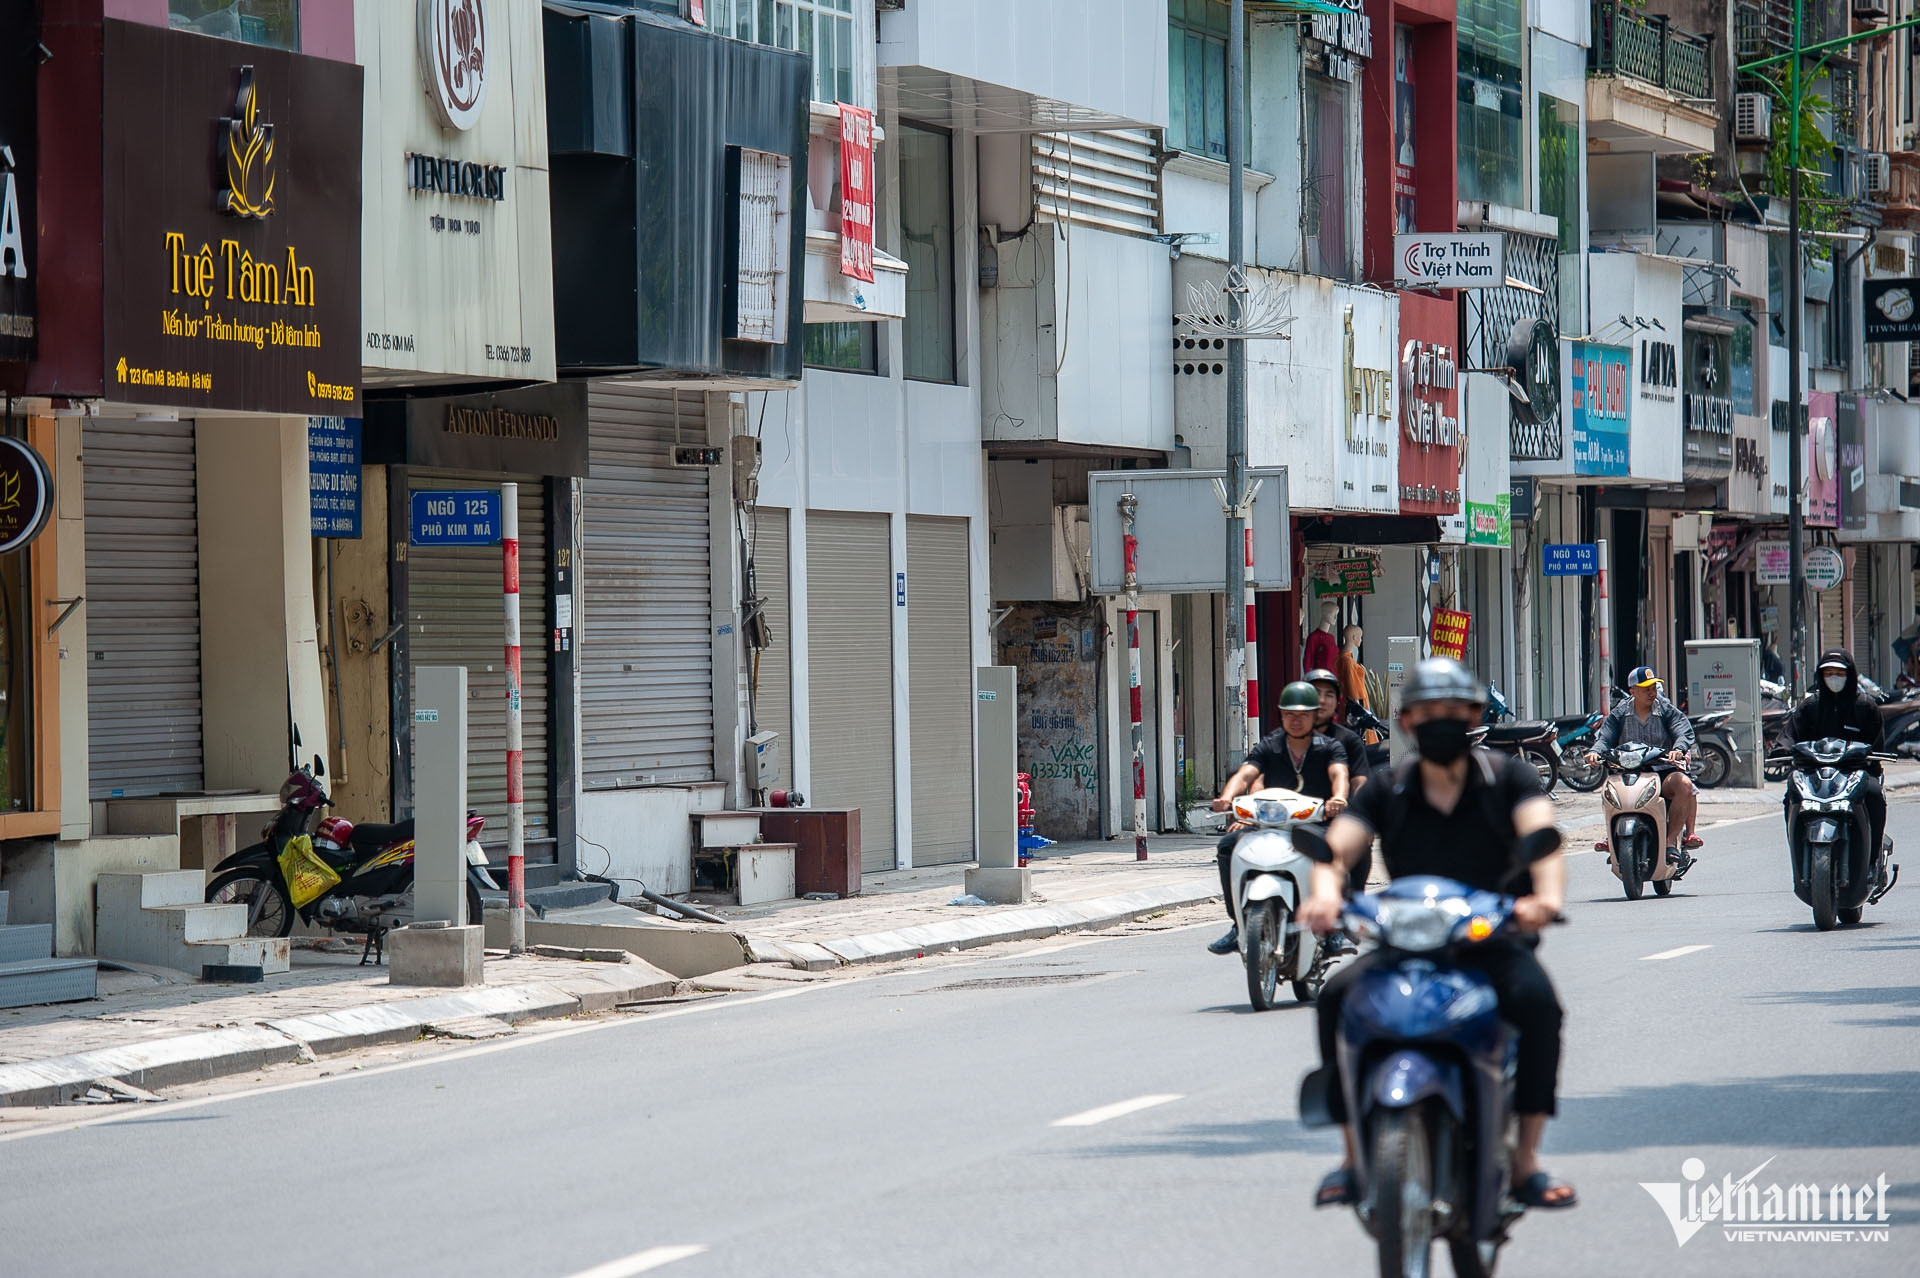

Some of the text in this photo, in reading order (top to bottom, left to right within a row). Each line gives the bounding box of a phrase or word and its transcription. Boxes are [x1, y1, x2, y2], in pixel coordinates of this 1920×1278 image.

[850, 154, 863, 191] NHÀ
[1422, 241, 1490, 260] Trợ Thính
[165, 231, 315, 310] Tuệ Tâm An
[1422, 261, 1493, 279] Việt Nam
[162, 309, 183, 336] Nến
[184, 313, 199, 337] bơ
[204, 313, 233, 341] Trầm
[234, 317, 264, 350] hương
[271, 318, 285, 345] Đồ
[366, 332, 415, 352] ADD: 125 KIM MÃ
[485, 344, 495, 360] TEL:
[496, 345, 510, 362] 0366
[129, 368, 212, 393] 123 Kim Mã Ba Đình Hà Nội
[317, 383, 354, 402] 0979 518 225
[449, 404, 560, 442] ANTONI FERNANDO
[1435, 400, 1458, 447] Nam
[331, 474, 339, 491] DI
[340, 470, 357, 496] ĐỘNG
[427, 496, 489, 516] NGÕ 125
[447, 524, 467, 536] KIM
[474, 520, 491, 536] MÃ
[396, 541, 407, 562] 127
[557, 548, 571, 567] 127
[1577, 549, 1591, 559] 143
[1436, 612, 1467, 629] BÁNH
[1433, 628, 1464, 646] CUỐN
[1431, 644, 1462, 661] NÓNG
